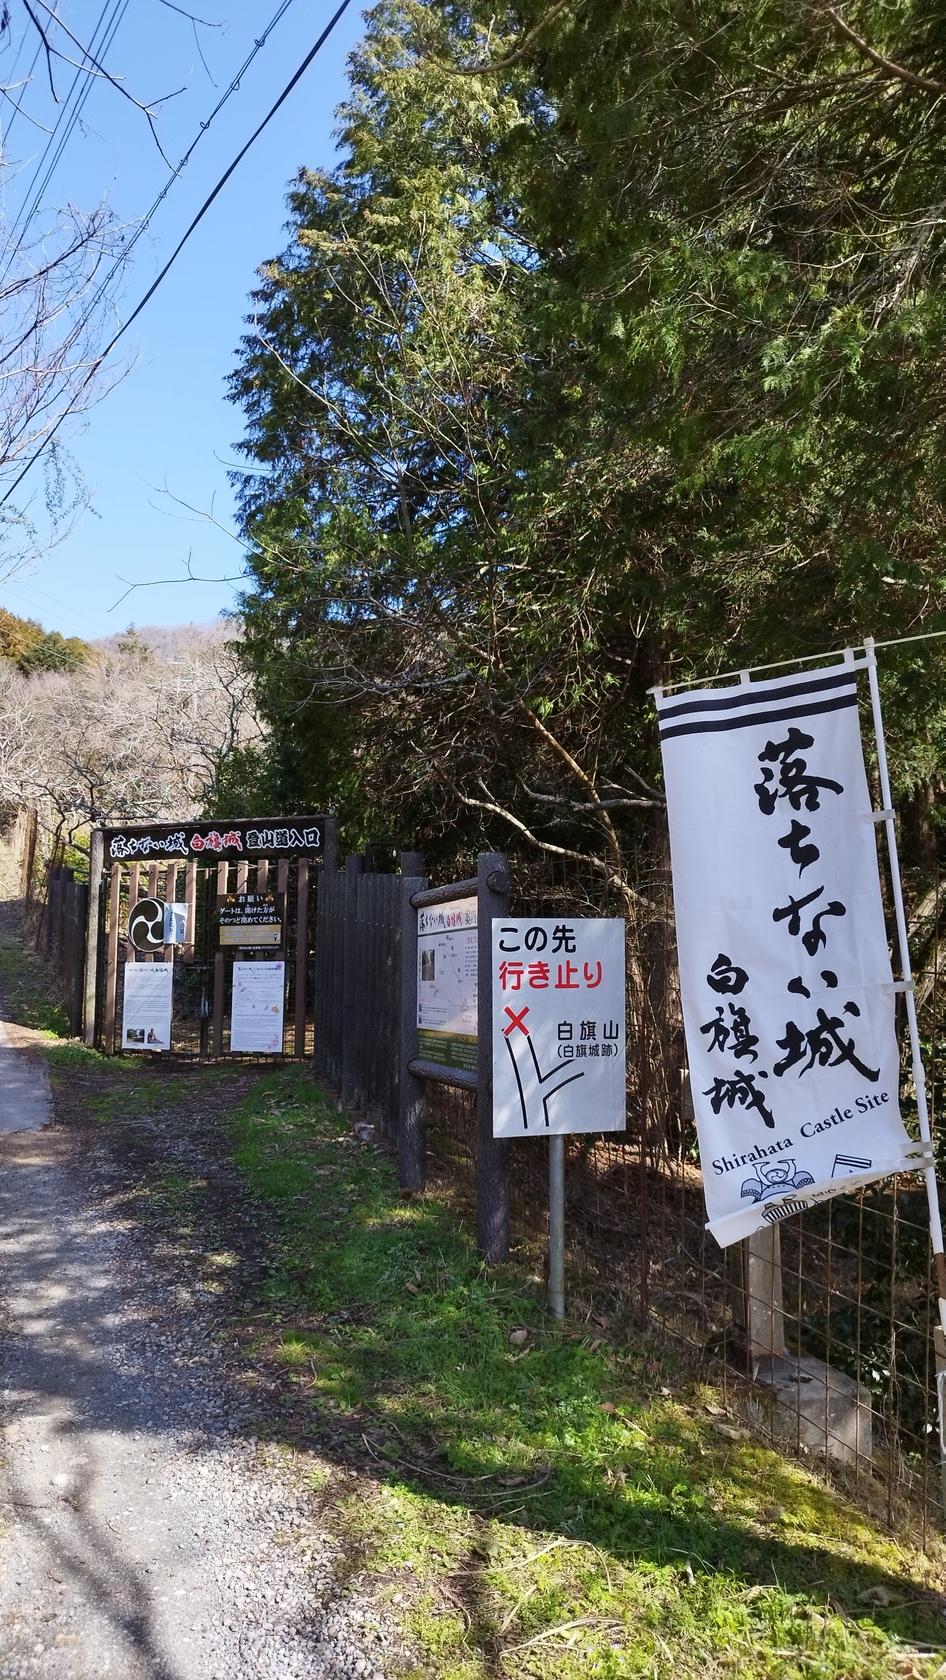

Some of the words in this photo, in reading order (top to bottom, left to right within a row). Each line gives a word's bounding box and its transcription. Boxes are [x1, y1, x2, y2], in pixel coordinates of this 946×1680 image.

[111, 832, 188, 857] 落ちない城
[190, 831, 243, 852] 白旗城
[246, 827, 320, 849] 登山道入口
[754, 727, 880, 1082] 落ちない城
[498, 924, 577, 953] この先
[499, 959, 603, 991] 行き止り
[557, 1021, 619, 1041] 白旗山
[700, 952, 775, 1128] 白旗城
[712, 1138, 794, 1176] Shirahata
[800, 1107, 854, 1139] Castle
[854, 1091, 890, 1114] Site
